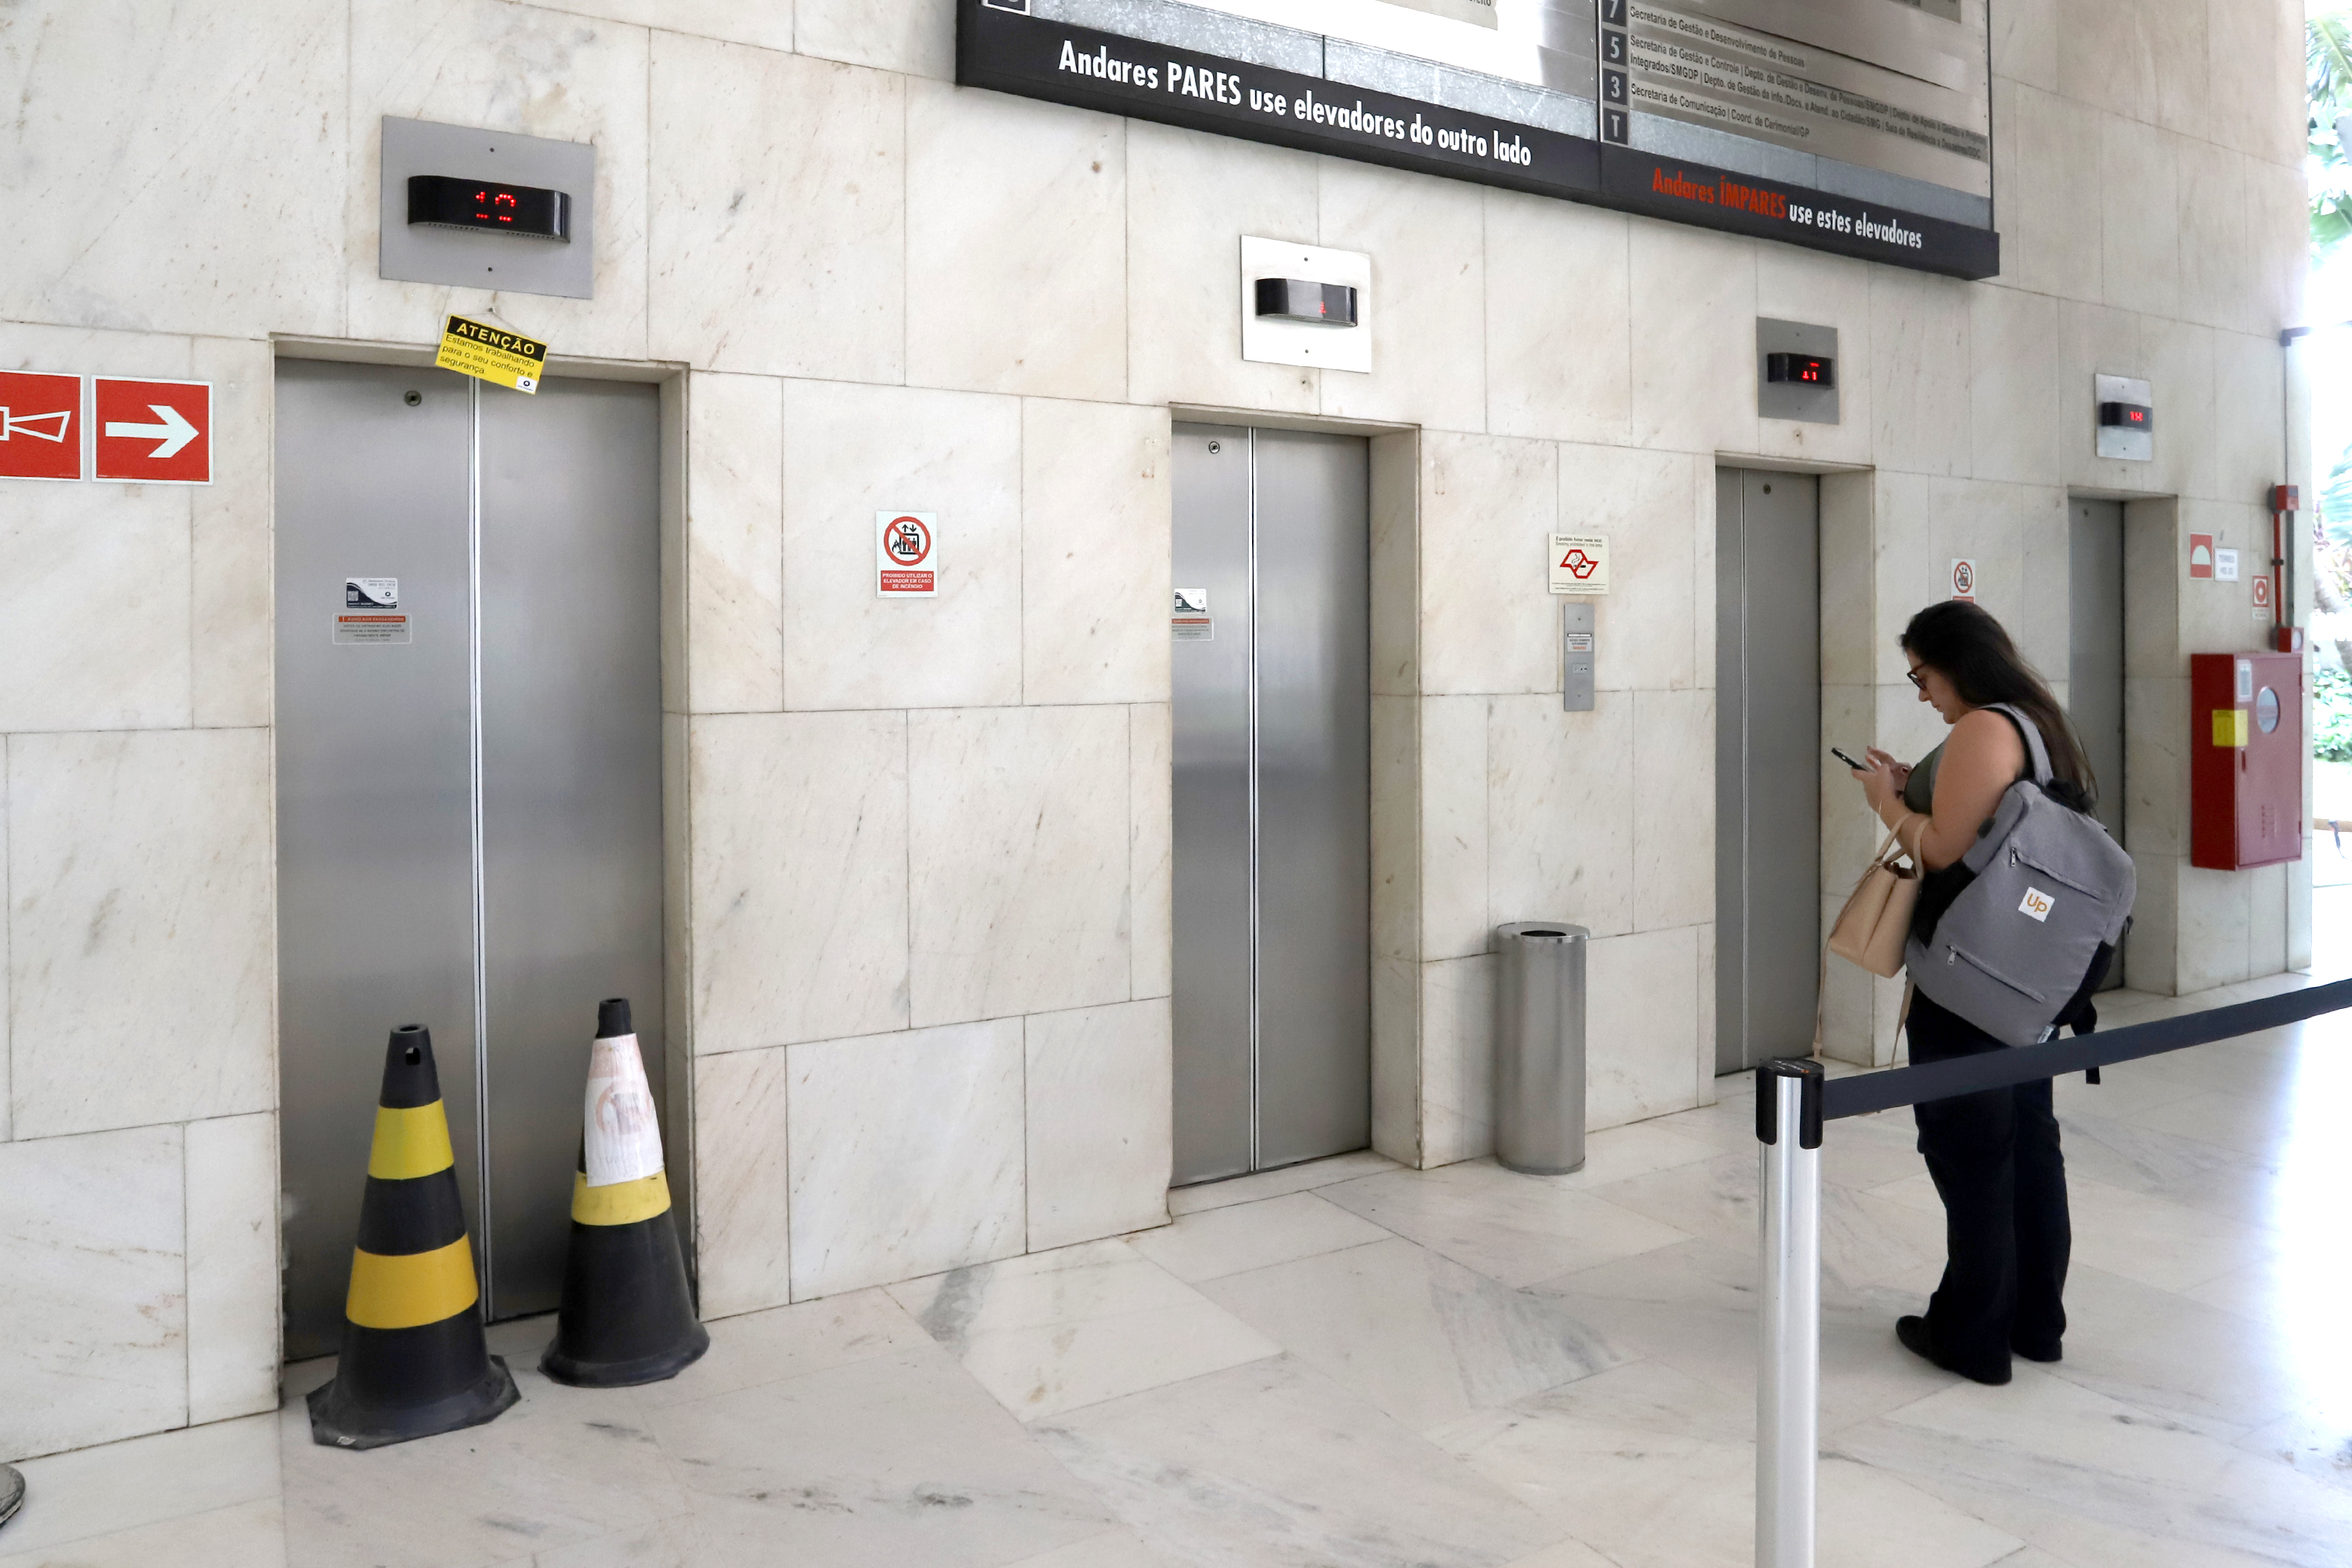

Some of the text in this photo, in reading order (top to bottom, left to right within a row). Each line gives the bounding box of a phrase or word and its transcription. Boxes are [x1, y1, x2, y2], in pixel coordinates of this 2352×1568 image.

[1610, 36, 1620, 59] 5
[1631, 6, 1805, 67] Secretaria de Gestão e Desenvolvimento de Pessoas
[1631, 35, 1666, 55] Secretaria
[1668, 45, 1678, 57] de
[1679, 48, 1703, 64] Gestão
[1711, 57, 1739, 74] Controle
[1744, 66, 1765, 82] Depto.
[1766, 72, 1775, 84] de
[1776, 74, 1798, 91] Gestão
[1799, 84, 1803, 93] e
[1610, 76, 1621, 98] 3
[1631, 53, 1698, 80] Integrados/SMGDP
[1704, 72, 1725, 88] Depto.
[1727, 80, 1736, 91] de
[1737, 82, 1760, 97] Gestão
[1762, 89, 1769, 100] da
[1810, 102, 1830, 116] Atend.
[1058, 40, 1532, 167] Andares PARES use elevadores do outro lado
[1631, 83, 1668, 103] Secretaria
[1669, 93, 1678, 105] de
[1680, 96, 1726, 118] Comunicação
[1731, 109, 1753, 124] Coord.
[1755, 115, 1763, 127] de
[1764, 117, 1809, 139] Cerimonial/GP
[1610, 115, 1621, 136] T
[1653, 168, 1922, 249] Andares ÍMPARES use estes elevadores
[445, 334, 535, 368] Estamos trabalhando
[456, 322, 535, 355] ATENÇÃO
[440, 355, 486, 375] segurança.
[442, 346, 462, 357] para
[473, 354, 488, 365] seu
[491, 359, 525, 376] conforto
[2027, 893, 2047, 912] Up
